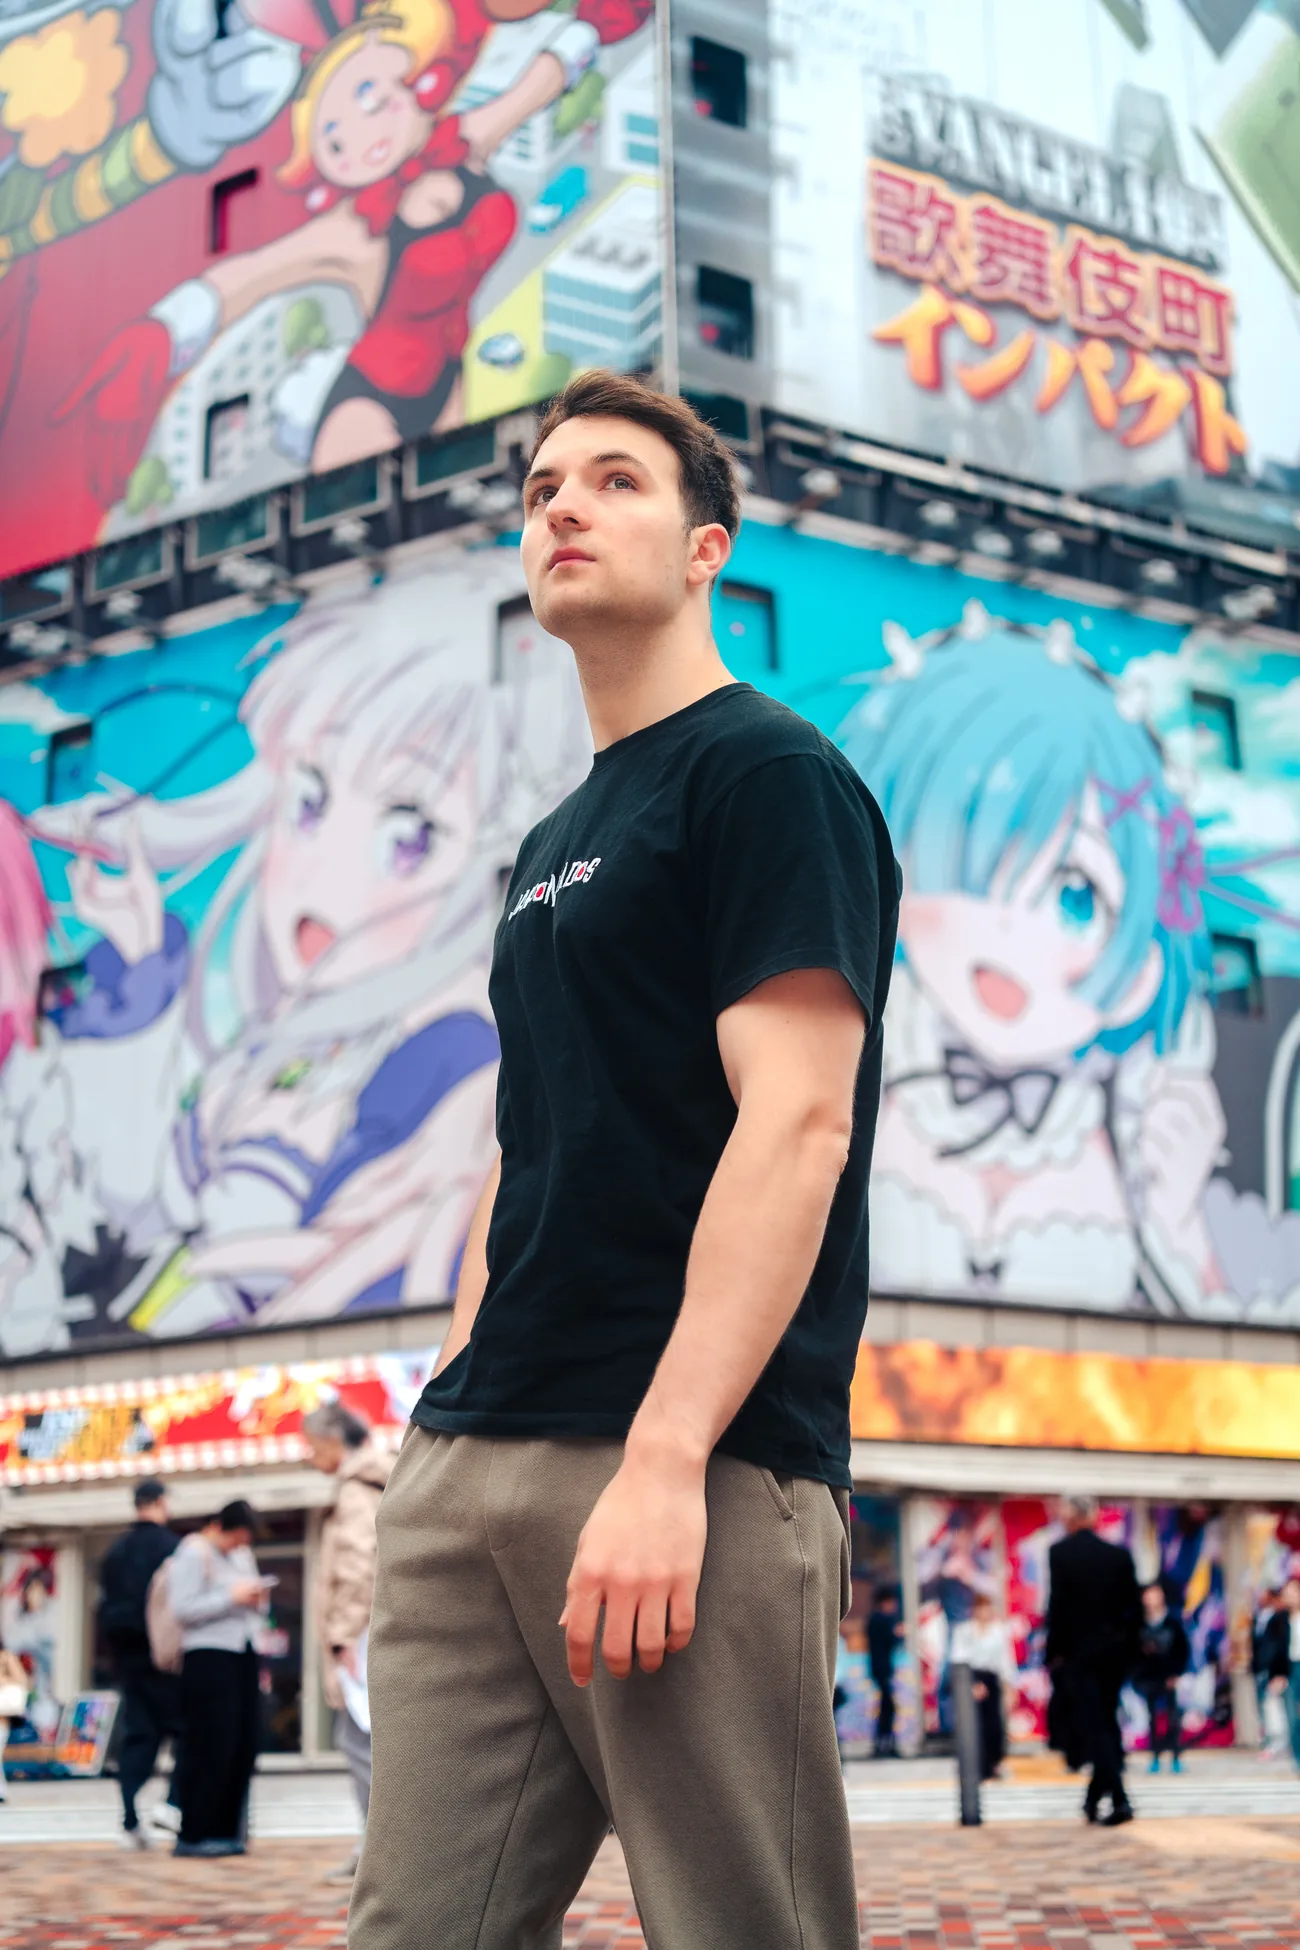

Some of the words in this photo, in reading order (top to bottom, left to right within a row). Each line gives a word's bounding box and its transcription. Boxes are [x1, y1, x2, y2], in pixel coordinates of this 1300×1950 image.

[867, 158, 1234, 376] 歌舞伎町
[872, 284, 1247, 475] インパクト
